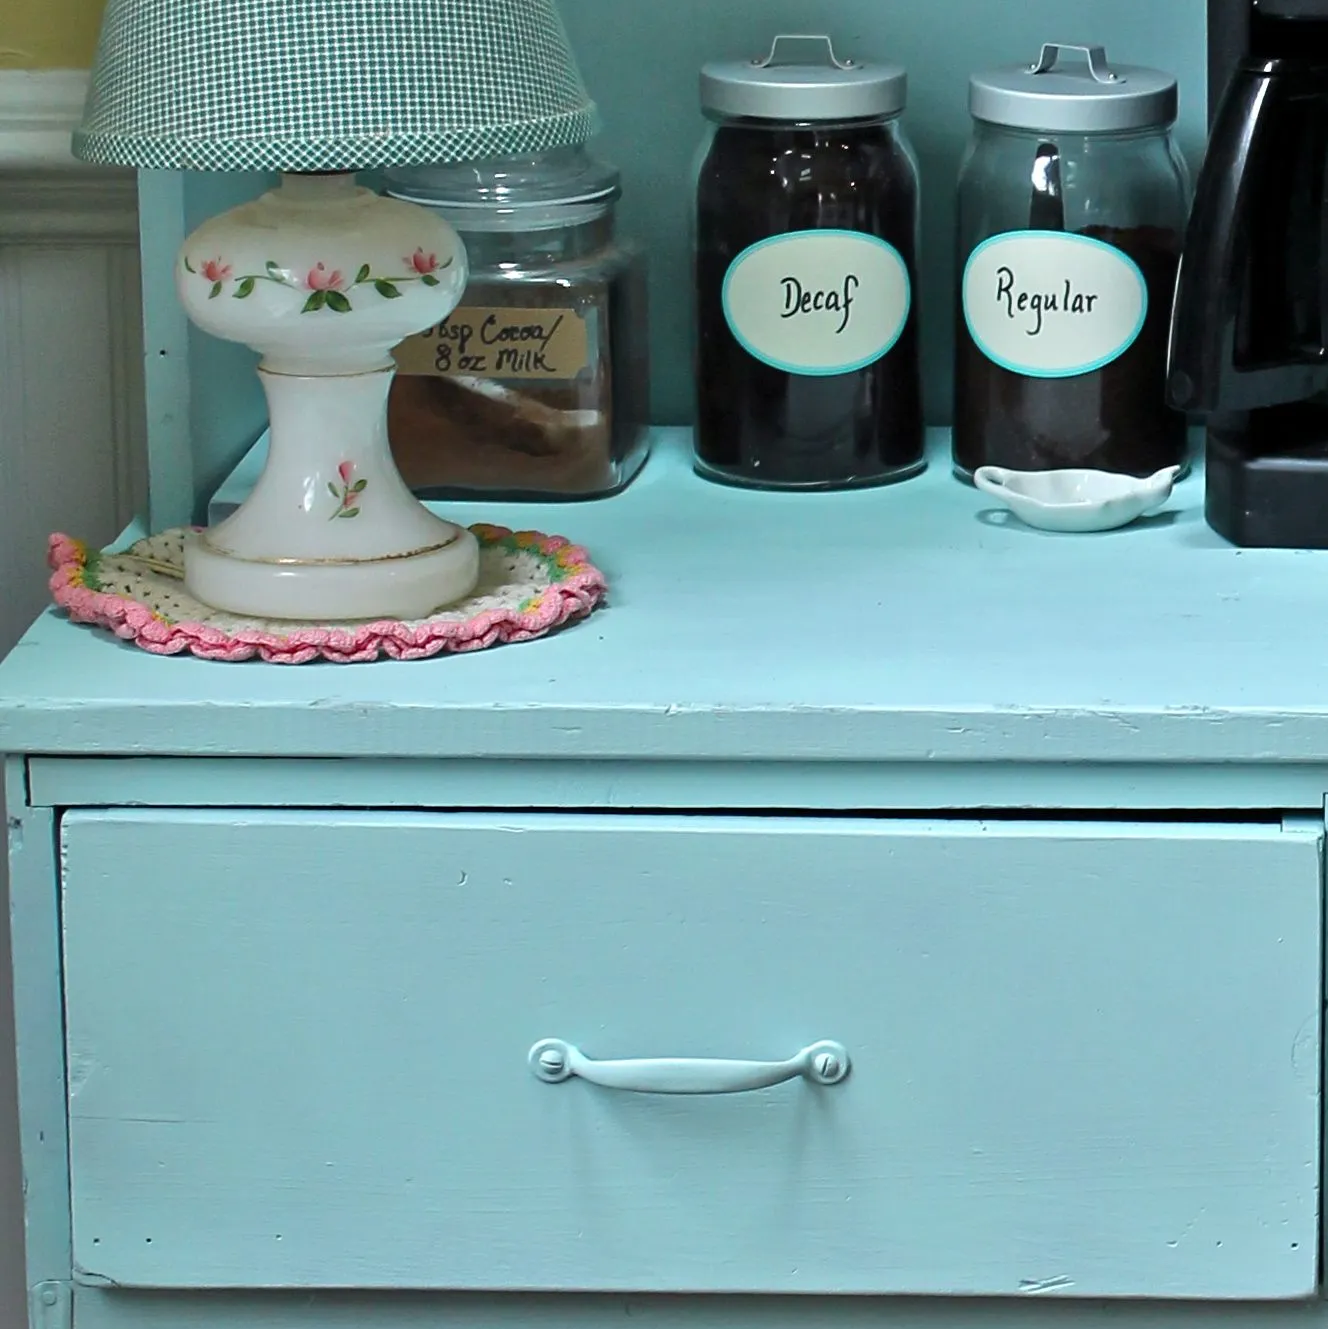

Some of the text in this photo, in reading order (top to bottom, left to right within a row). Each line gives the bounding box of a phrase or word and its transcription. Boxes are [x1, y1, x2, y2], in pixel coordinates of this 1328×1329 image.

[780, 275, 859, 334] Decaf
[996, 267, 1099, 335] Regular
[435, 343, 556, 372] 8 oz Milk
